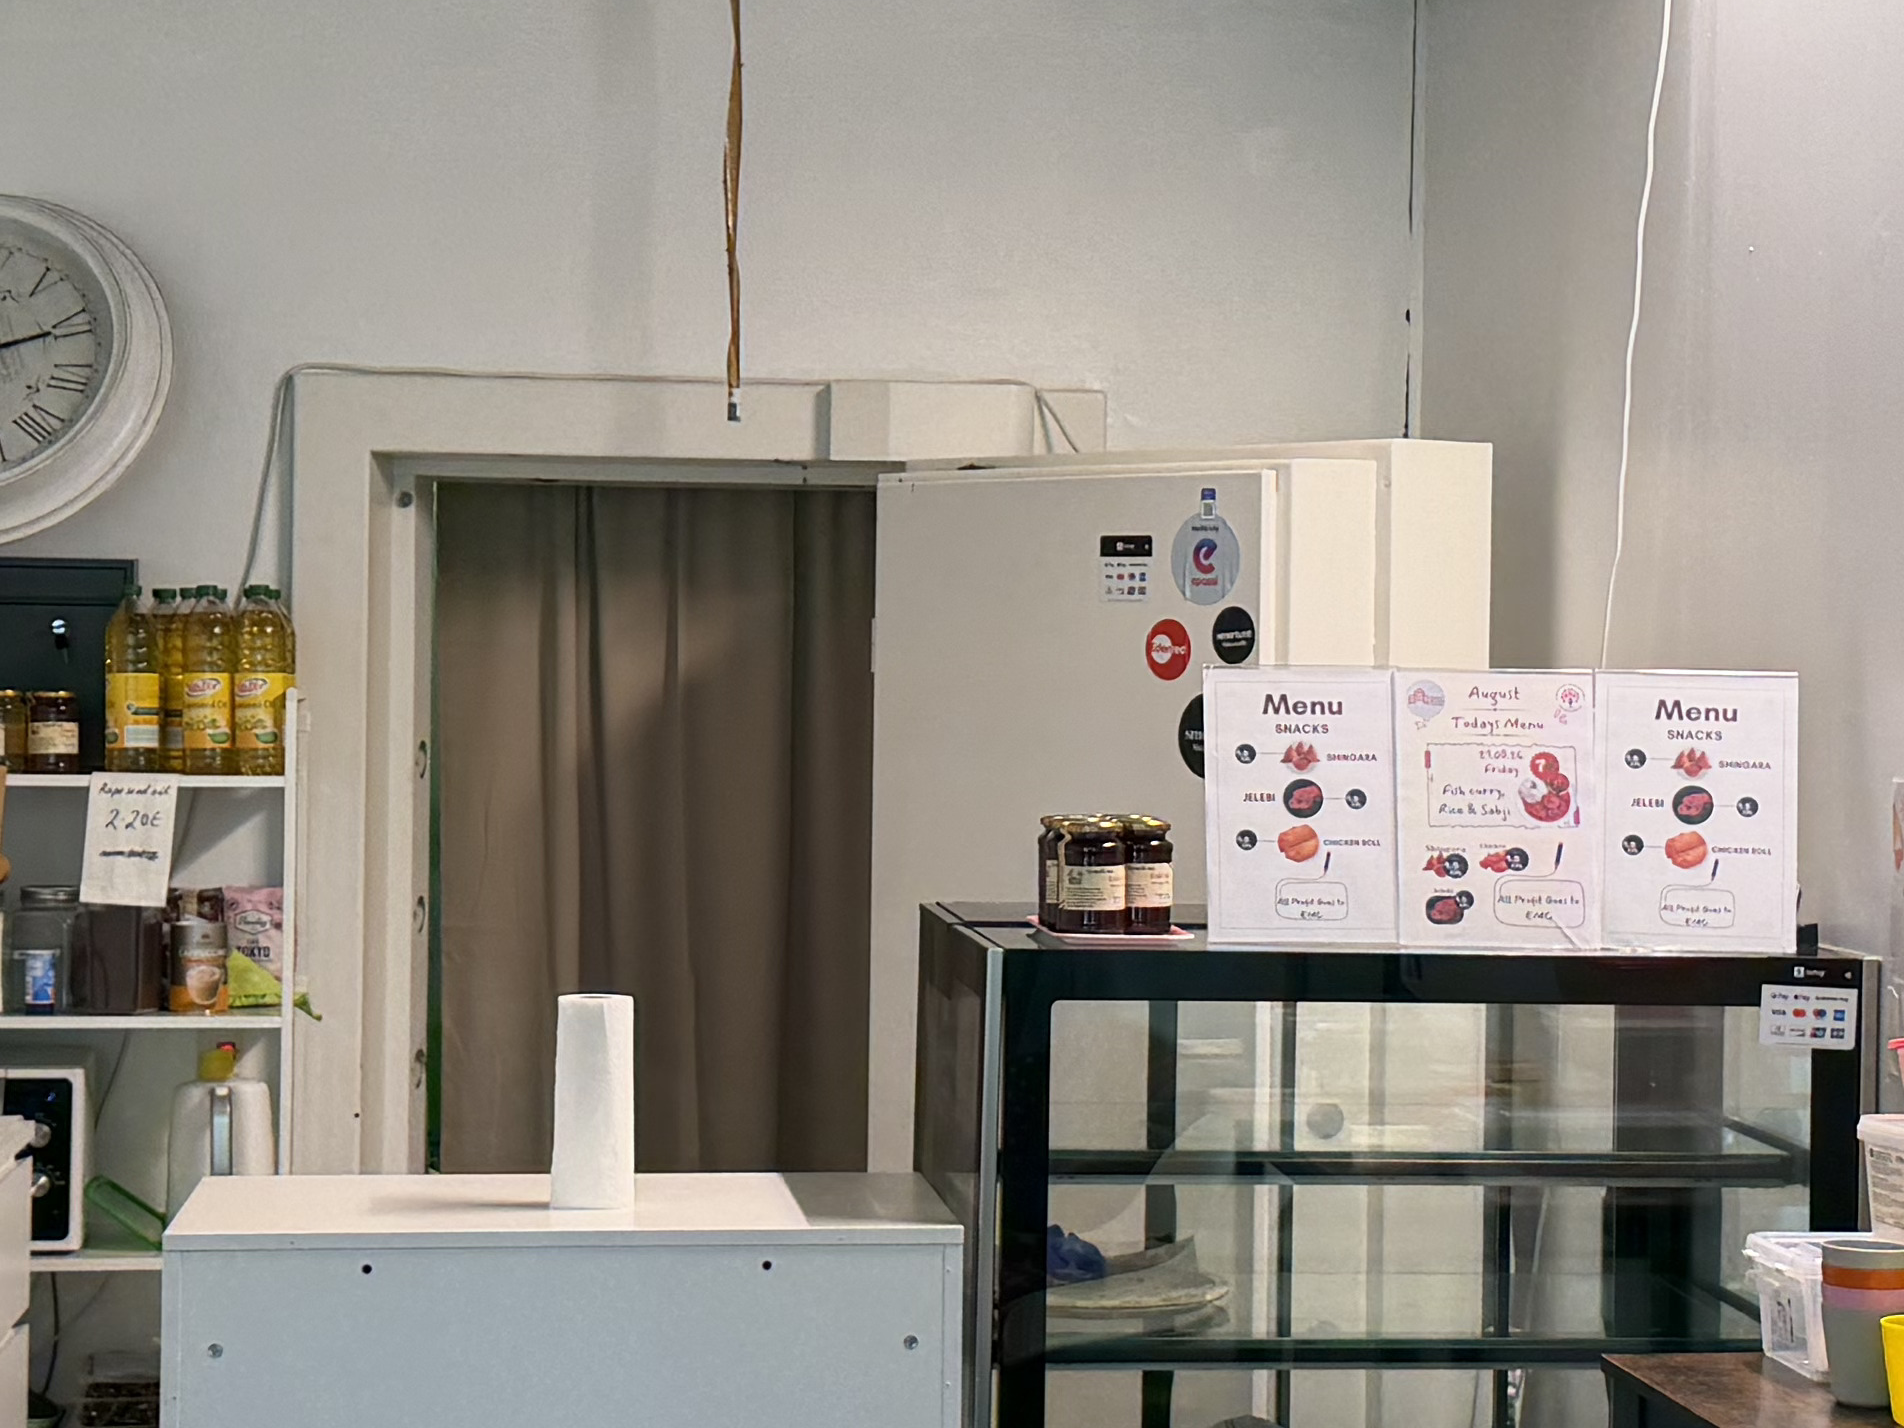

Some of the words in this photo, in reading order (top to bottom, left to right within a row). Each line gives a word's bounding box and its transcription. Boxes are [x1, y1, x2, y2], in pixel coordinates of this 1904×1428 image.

[1467, 685, 1521, 706] August
[1262, 693, 1344, 716] Menu
[1654, 698, 1739, 723] Menu
[1274, 723, 1330, 735] SNACKS
[1503, 717, 1544, 730] Menu
[1666, 729, 1724, 742] SNACKS
[1484, 763, 1519, 778] Friday
[1442, 783, 1466, 797] Fish
[1242, 792, 1276, 803] JELEBI
[1630, 797, 1665, 808] JELEBI
[1438, 802, 1465, 816] Rice
